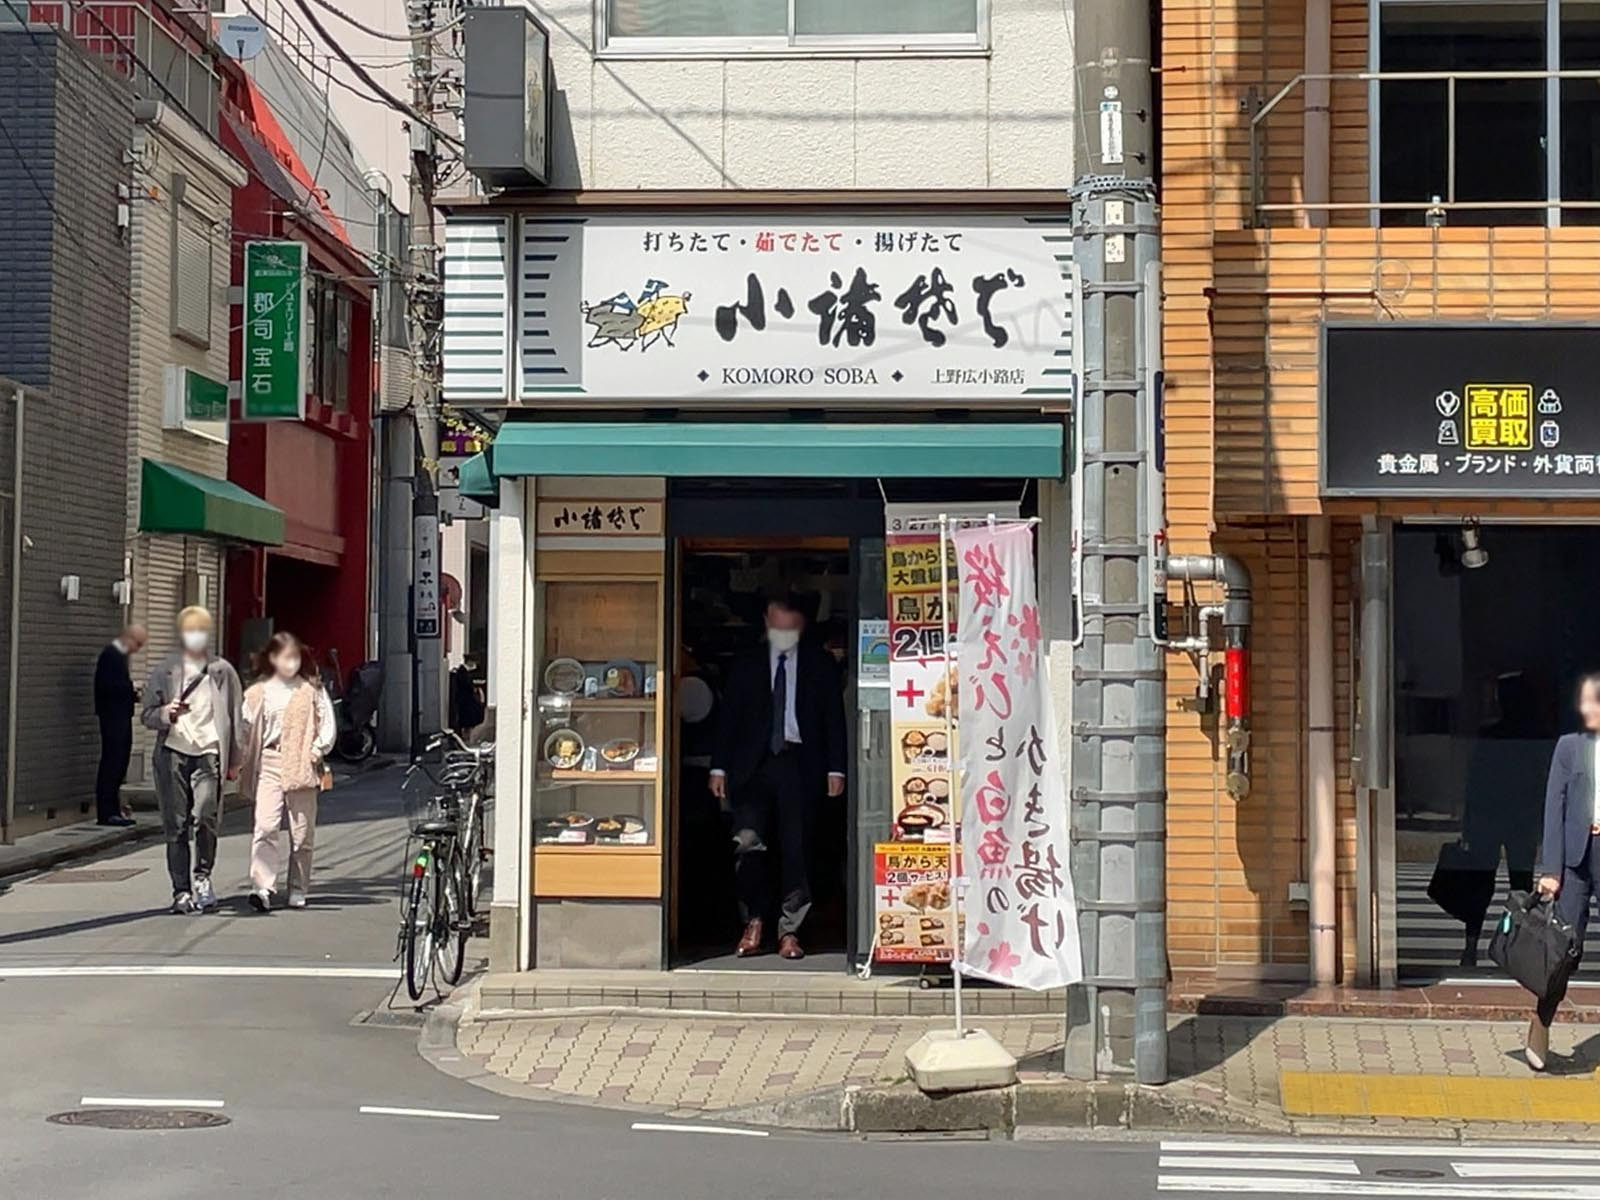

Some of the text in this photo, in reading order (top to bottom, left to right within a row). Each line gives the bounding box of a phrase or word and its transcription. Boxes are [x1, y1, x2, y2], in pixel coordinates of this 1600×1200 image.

[643, 231, 964, 252] 打ちたて・茹でたて・揚げたて
[251, 292, 275, 395] 郡司宝石
[722, 368, 879, 385] KOMORO SOBA
[931, 368, 1025, 386] 上野広小路店
[1469, 389, 1529, 418] 高価
[1469, 418, 1529, 447] 買取
